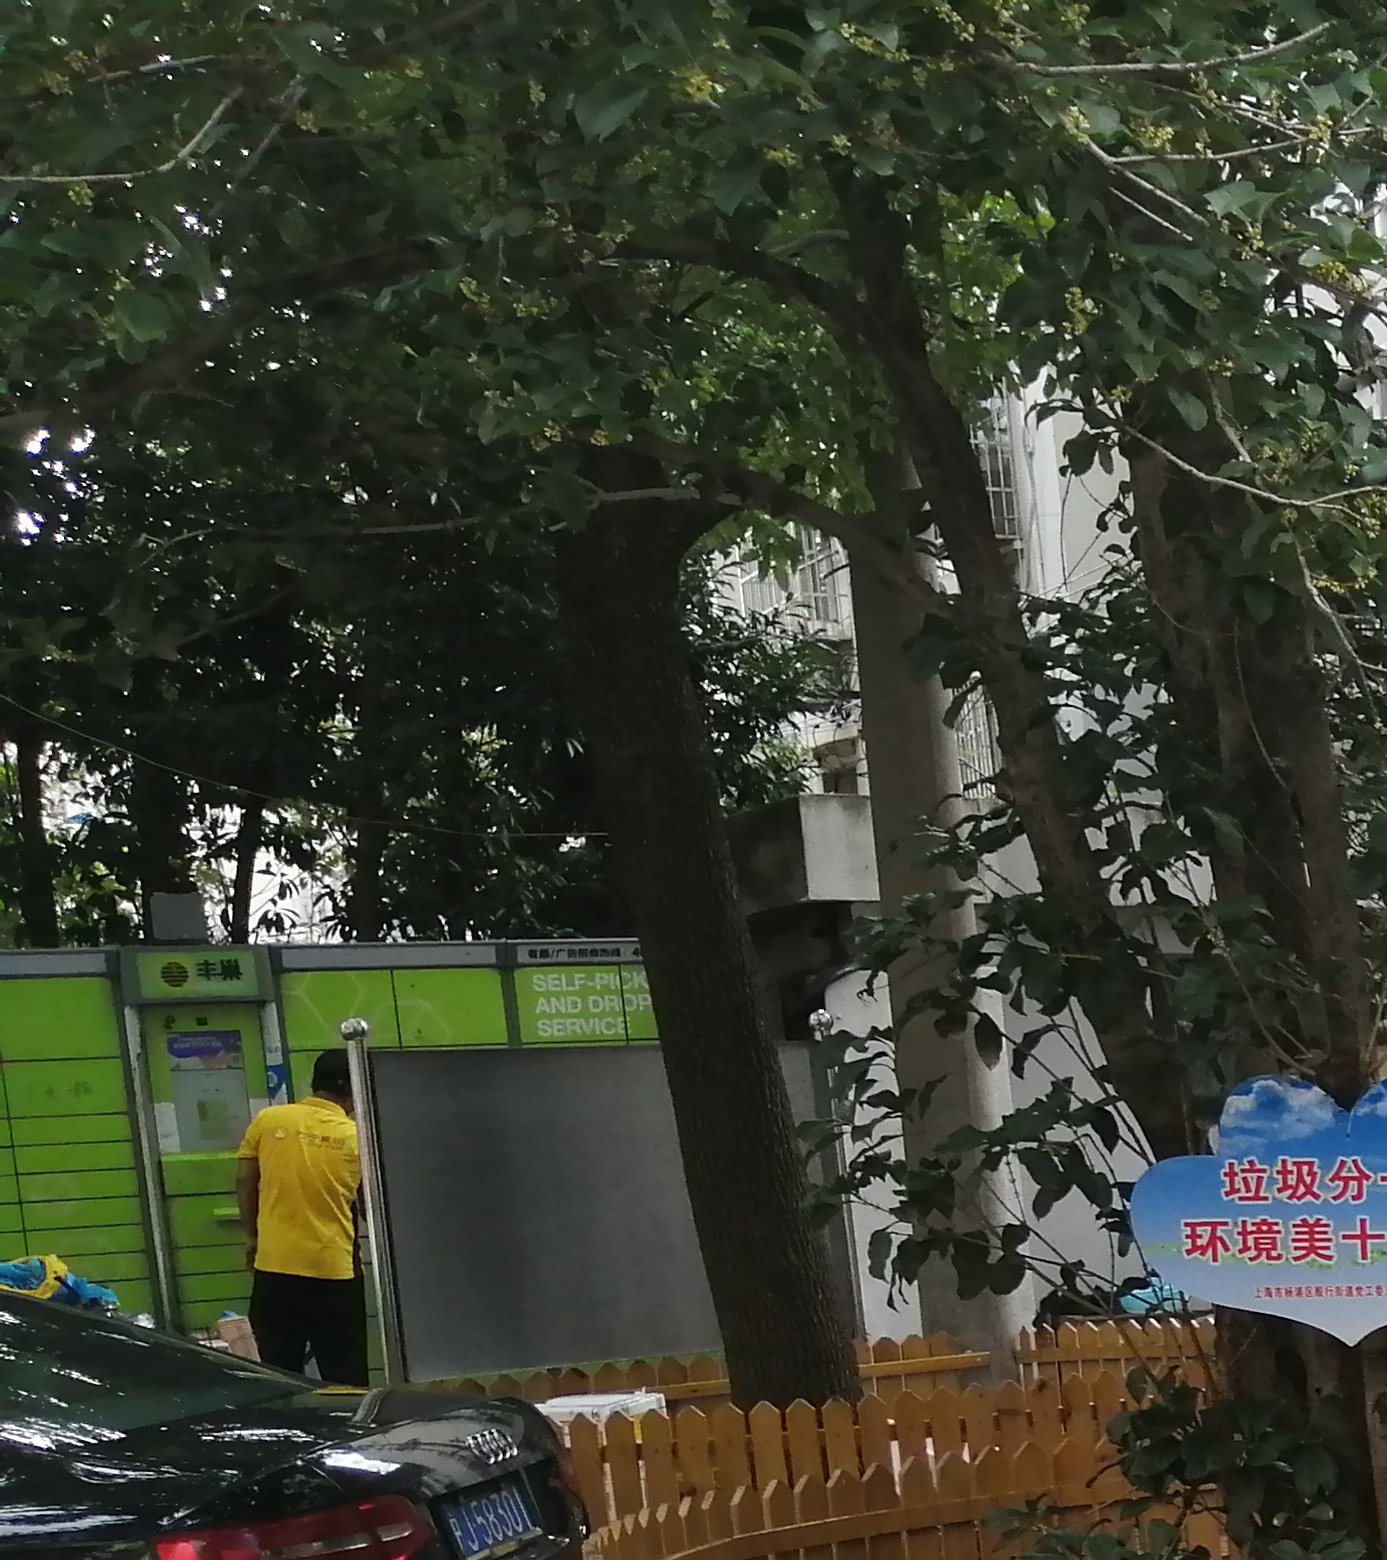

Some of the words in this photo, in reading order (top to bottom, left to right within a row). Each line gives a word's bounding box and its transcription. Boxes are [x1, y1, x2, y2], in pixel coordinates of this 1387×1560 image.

[532, 971, 649, 992] SELF-PICK
[536, 996, 582, 1014] AND
[589, 994, 652, 1012] DROP
[538, 1017, 631, 1036] SERVICE
